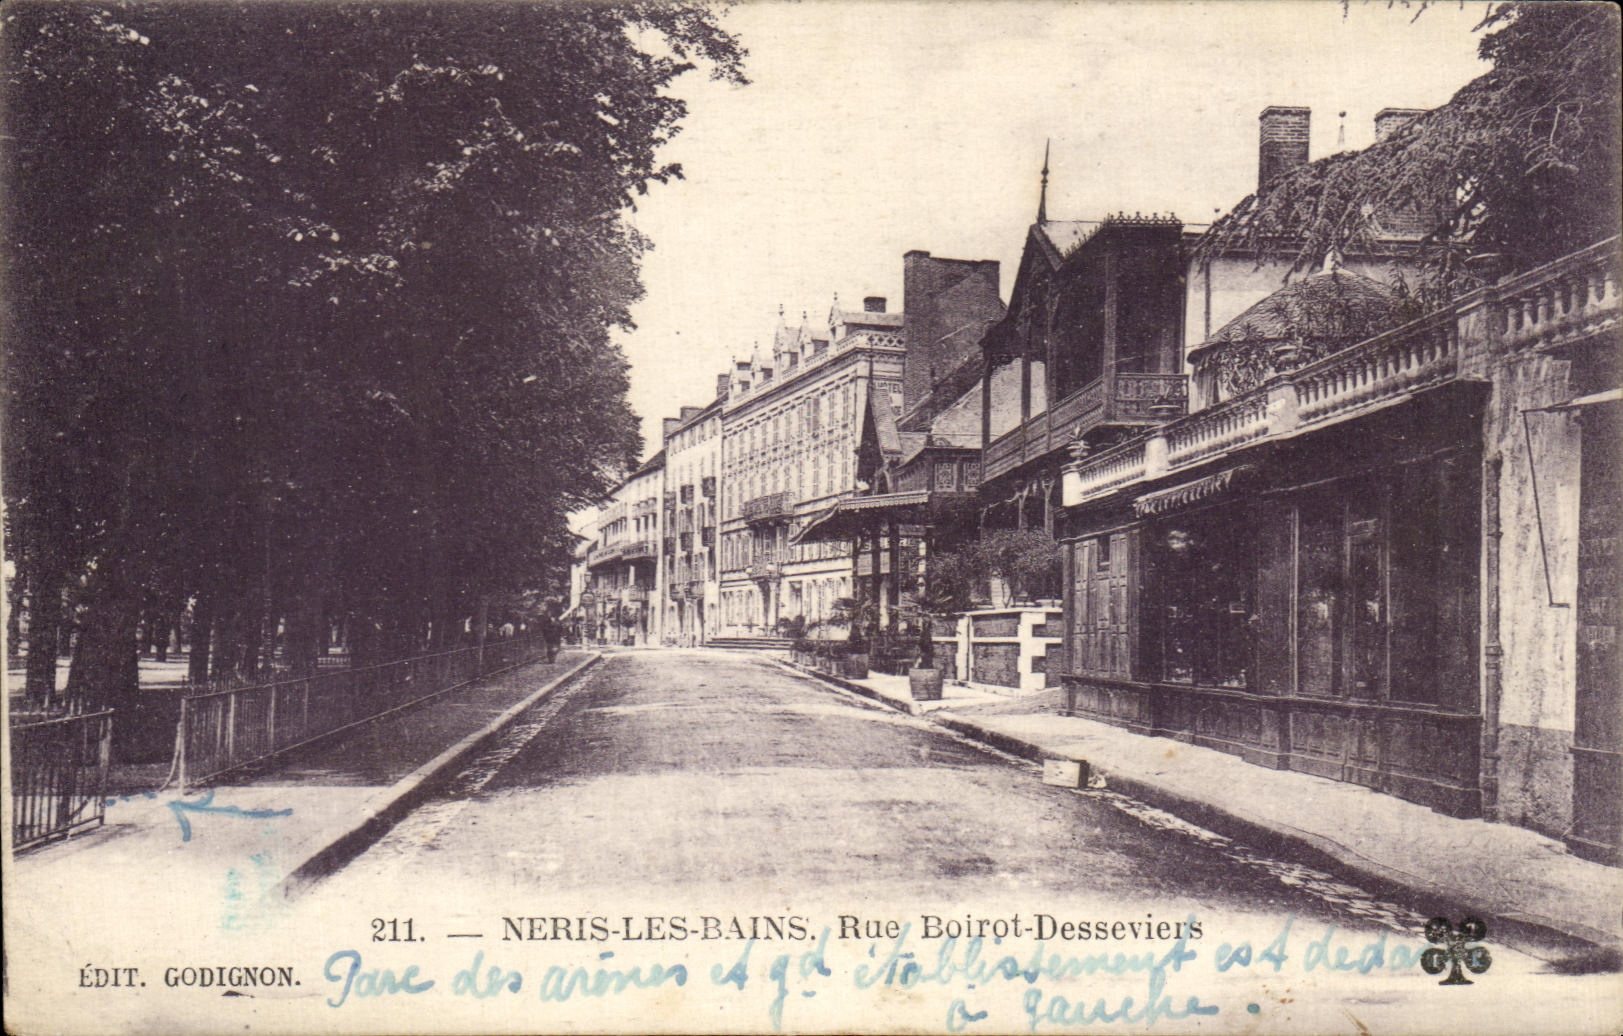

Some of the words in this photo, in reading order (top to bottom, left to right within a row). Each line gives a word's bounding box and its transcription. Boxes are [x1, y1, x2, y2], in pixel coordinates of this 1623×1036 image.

[323, 949, 435, 1008] Parc
[451, 950, 523, 999] des
[710, 936, 756, 990] et
[1214, 912, 1296, 973] est
[1303, 921, 1465, 975] deda
